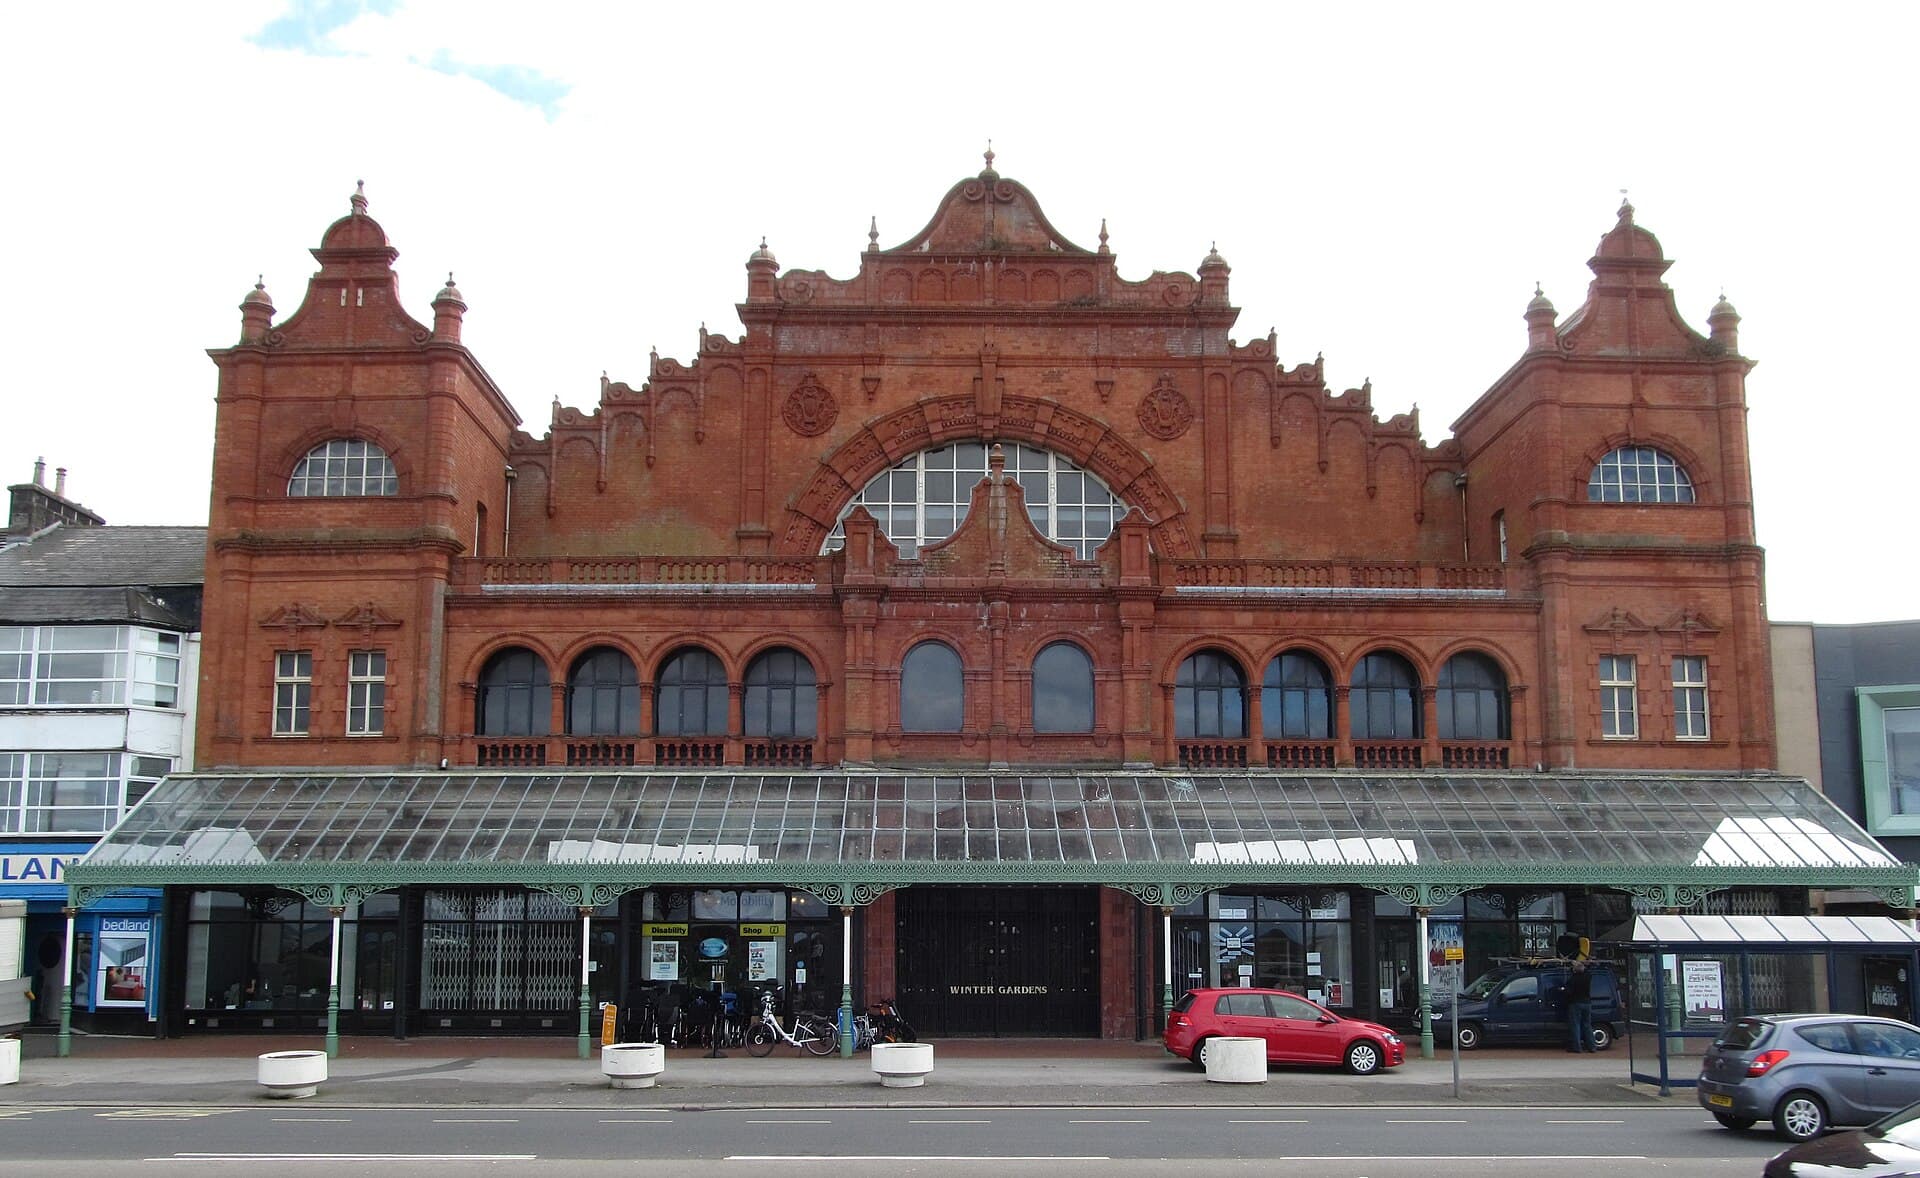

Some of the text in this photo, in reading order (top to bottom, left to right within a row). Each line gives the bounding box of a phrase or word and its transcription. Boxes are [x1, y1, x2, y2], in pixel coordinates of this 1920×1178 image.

[103, 918, 150, 931] bedland
[651, 926, 762, 935] Disability Shop
[1525, 938, 1549, 949] RCK
[950, 985, 1048, 994] WINTER GARDENS
